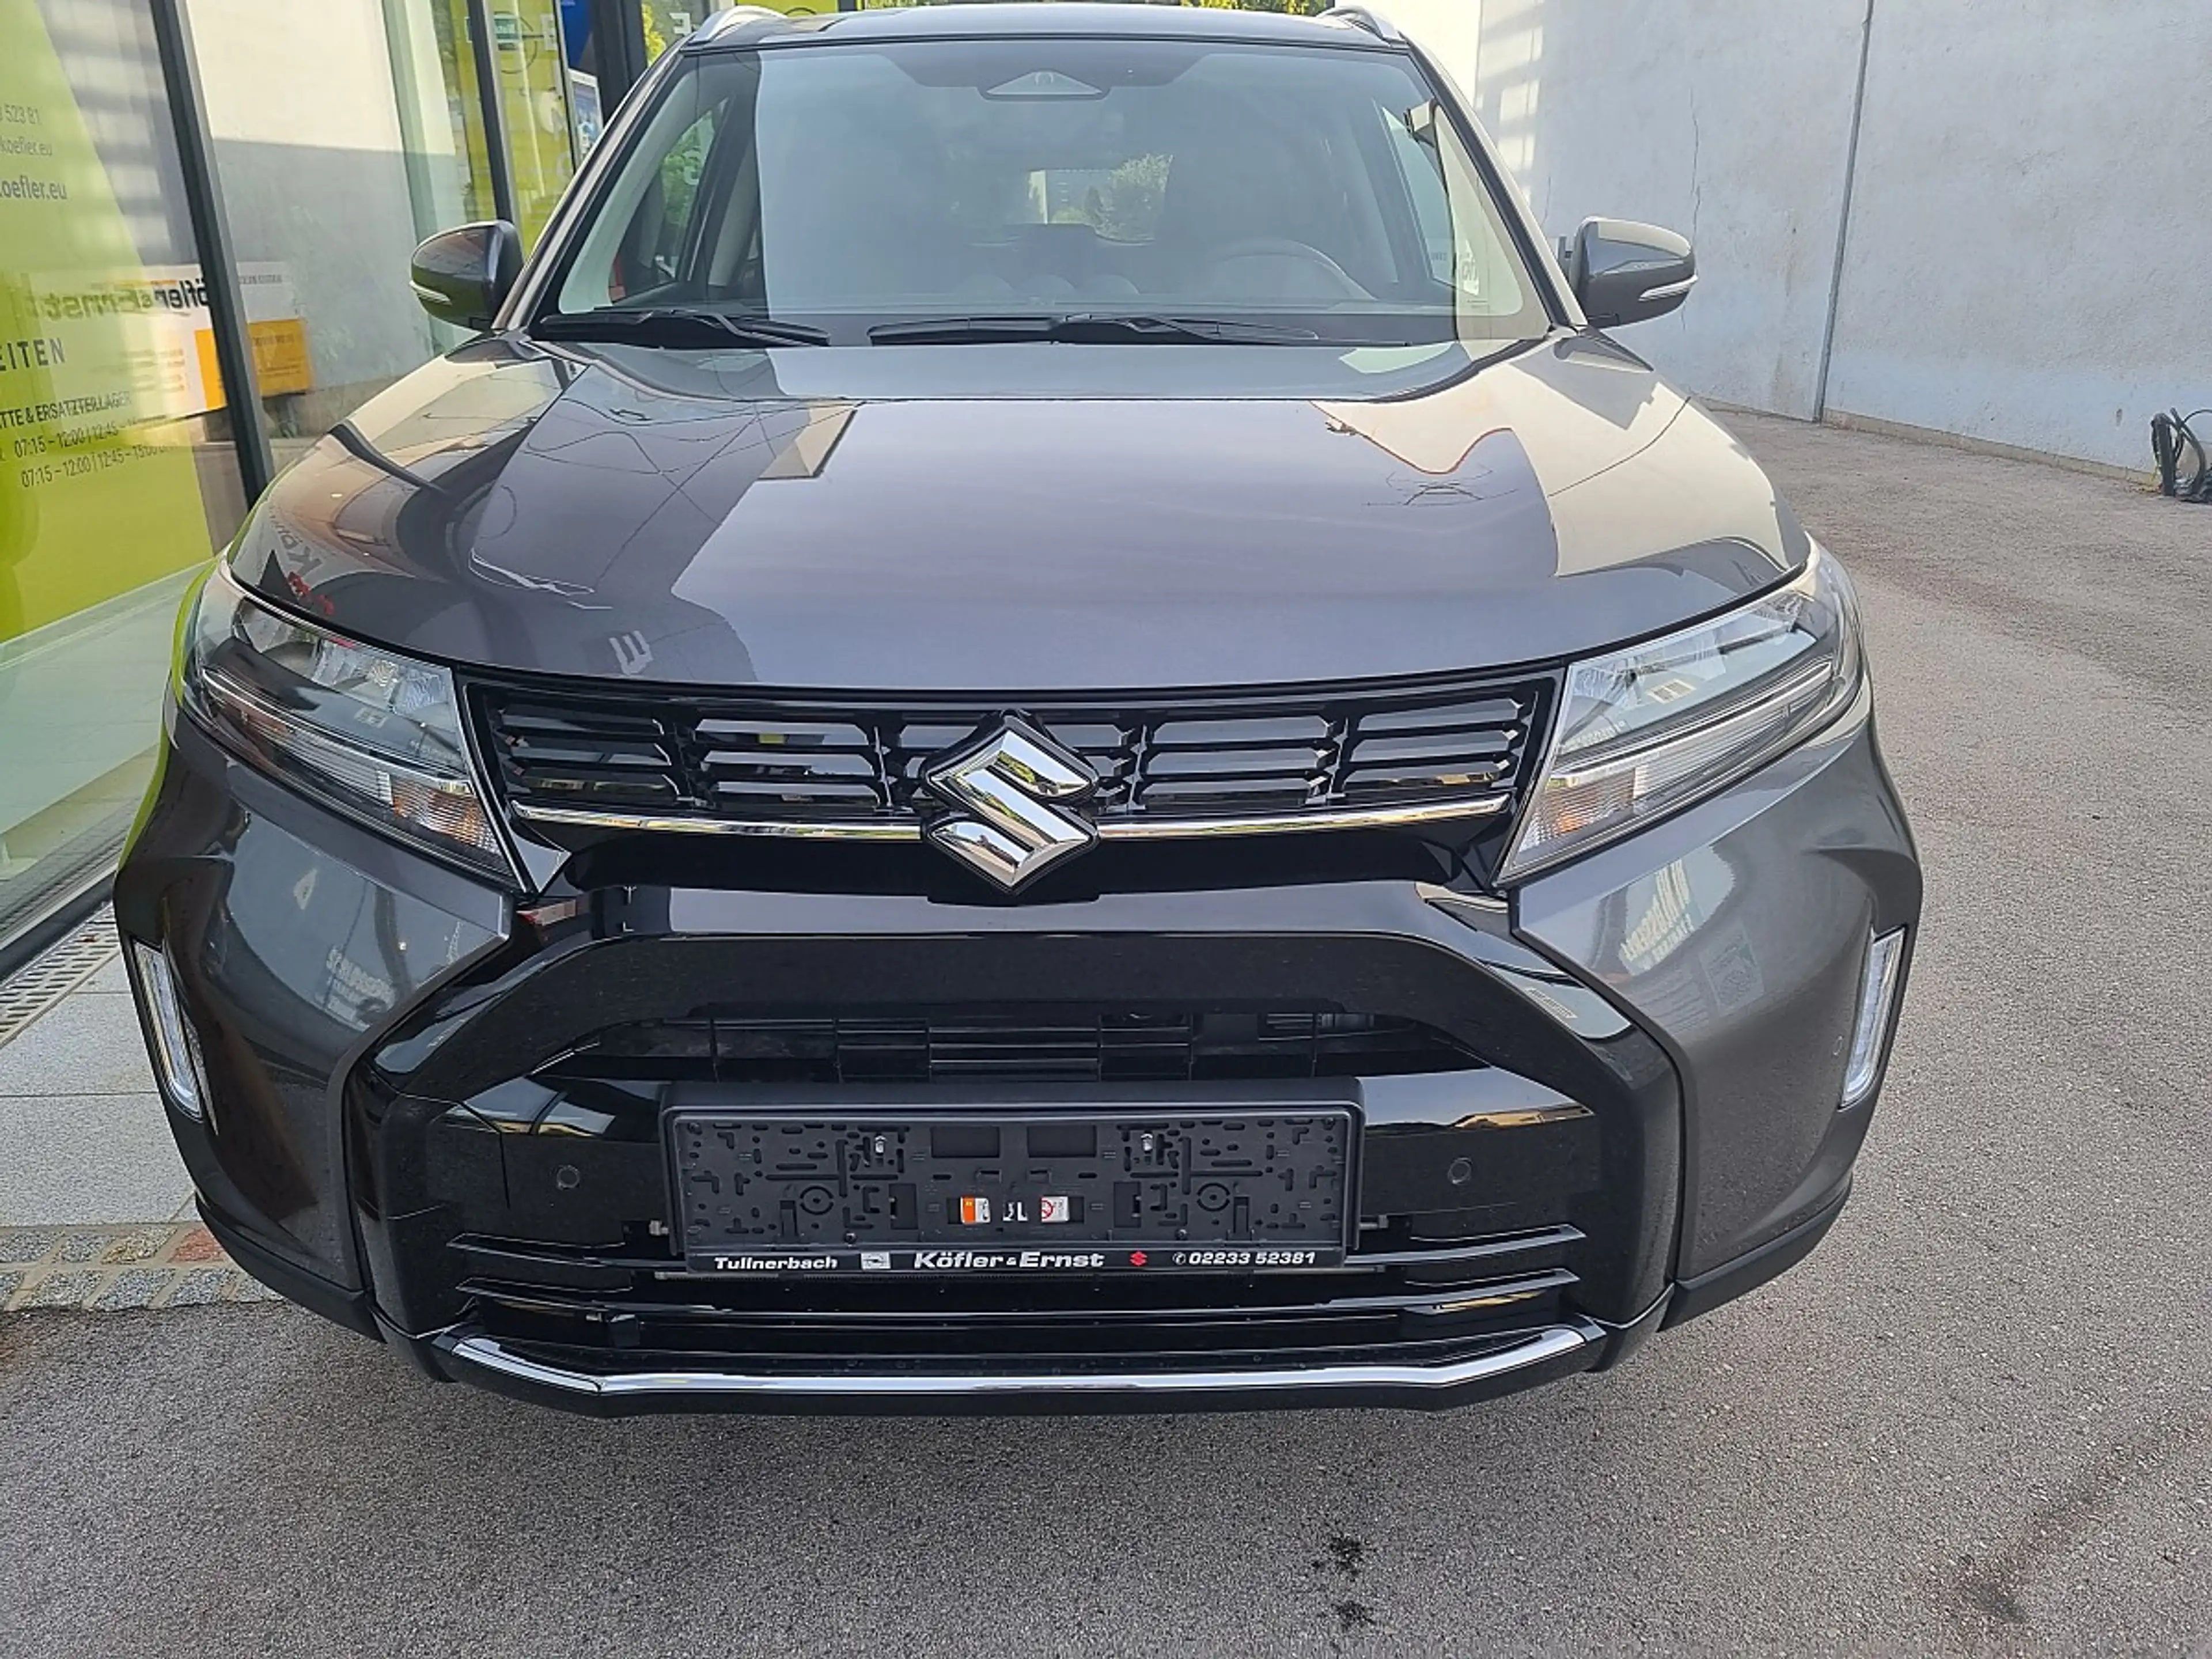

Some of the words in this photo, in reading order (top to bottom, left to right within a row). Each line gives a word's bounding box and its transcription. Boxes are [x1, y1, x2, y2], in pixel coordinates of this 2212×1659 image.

[5, 104, 26, 123] 523
[29, 108, 41, 125] 81
[0, 175, 67, 199] oefler.eu
[0, 408, 24, 430] TTE
[26, 406, 35, 423] &
[14, 435, 47, 458] 07:15
[21, 464, 52, 487] 07:15
[714, 1255, 838, 1270] Tullnerbach
[1188, 1251, 1251, 1265] 02233
[1255, 1251, 1316, 1265] 52381
